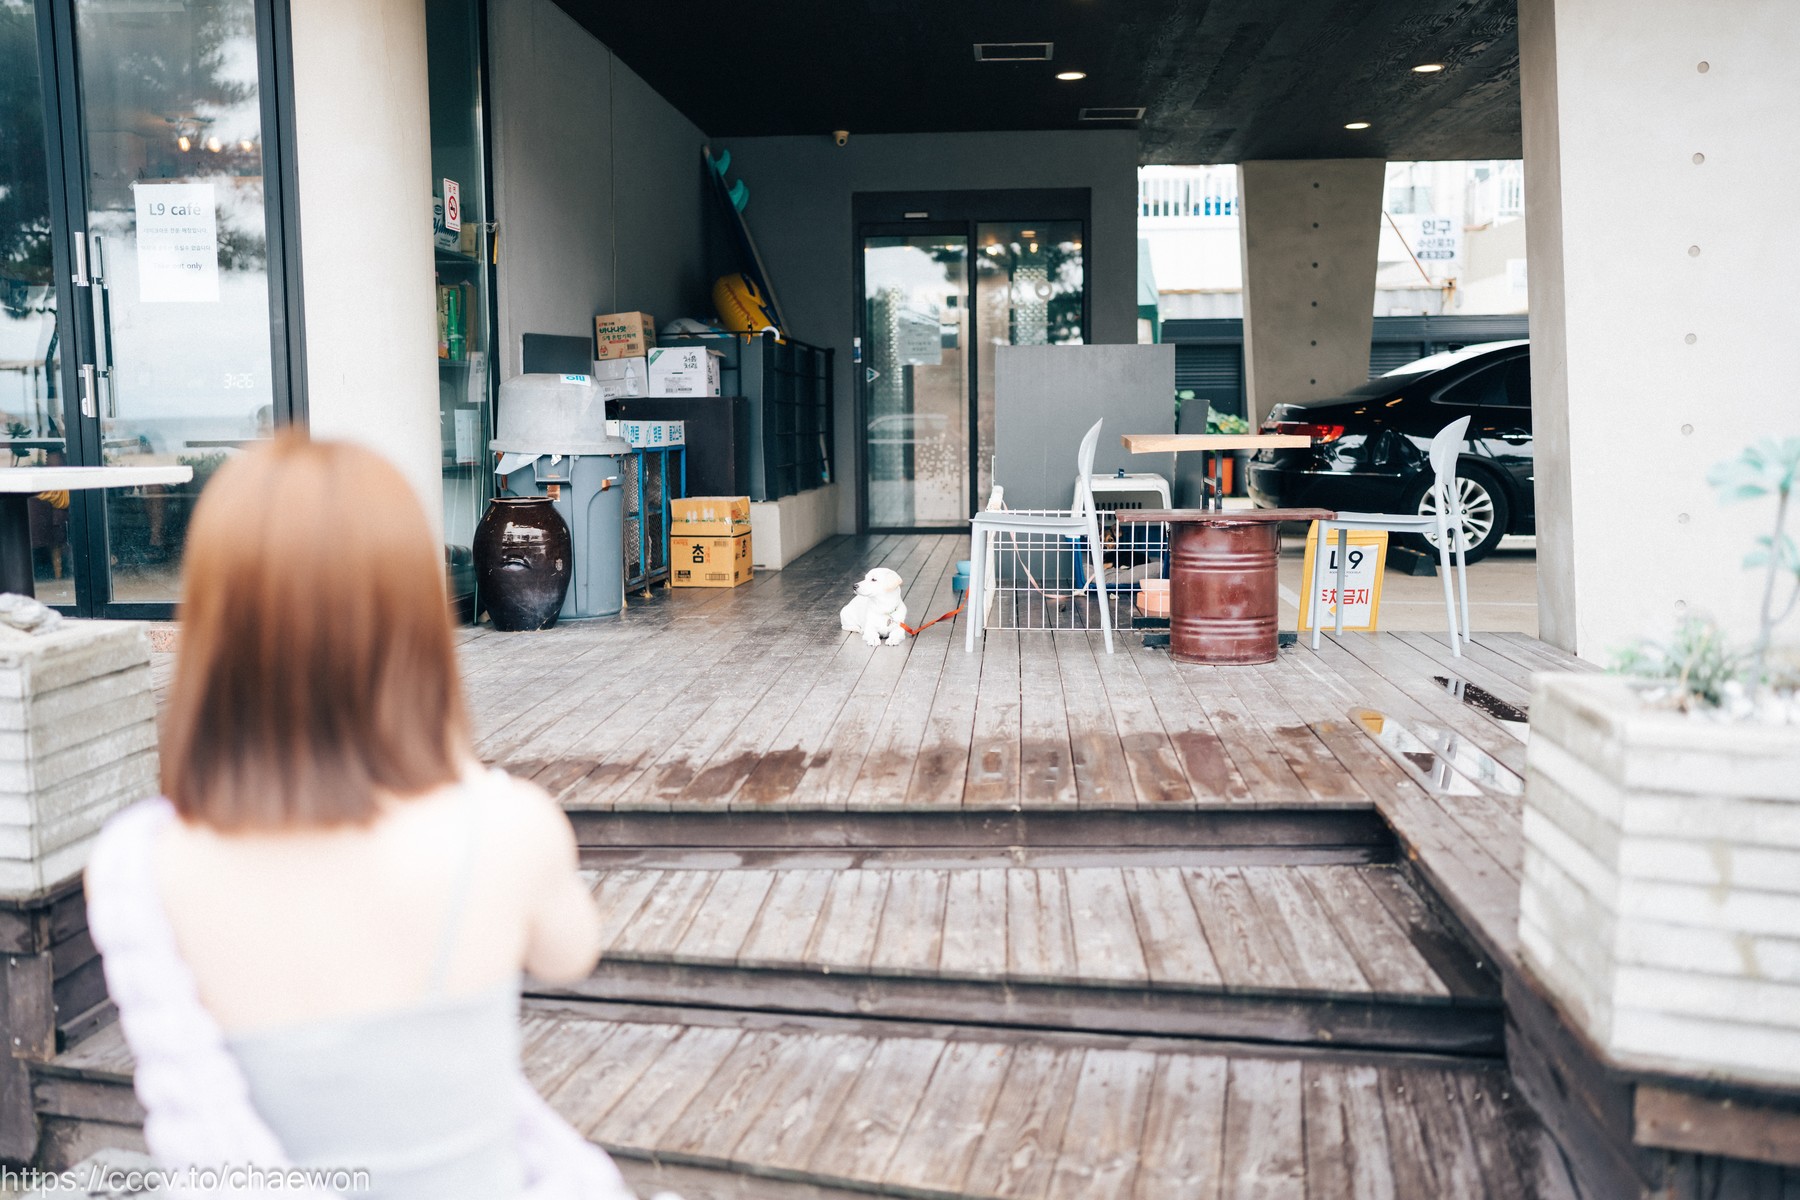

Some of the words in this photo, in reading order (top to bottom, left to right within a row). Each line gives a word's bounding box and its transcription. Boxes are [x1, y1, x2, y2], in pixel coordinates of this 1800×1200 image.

[149, 203, 165, 215] L9
[1422, 220, 1451, 235] 인구
[186, 261, 203, 271] only
[1329, 550, 1364, 569] L9
